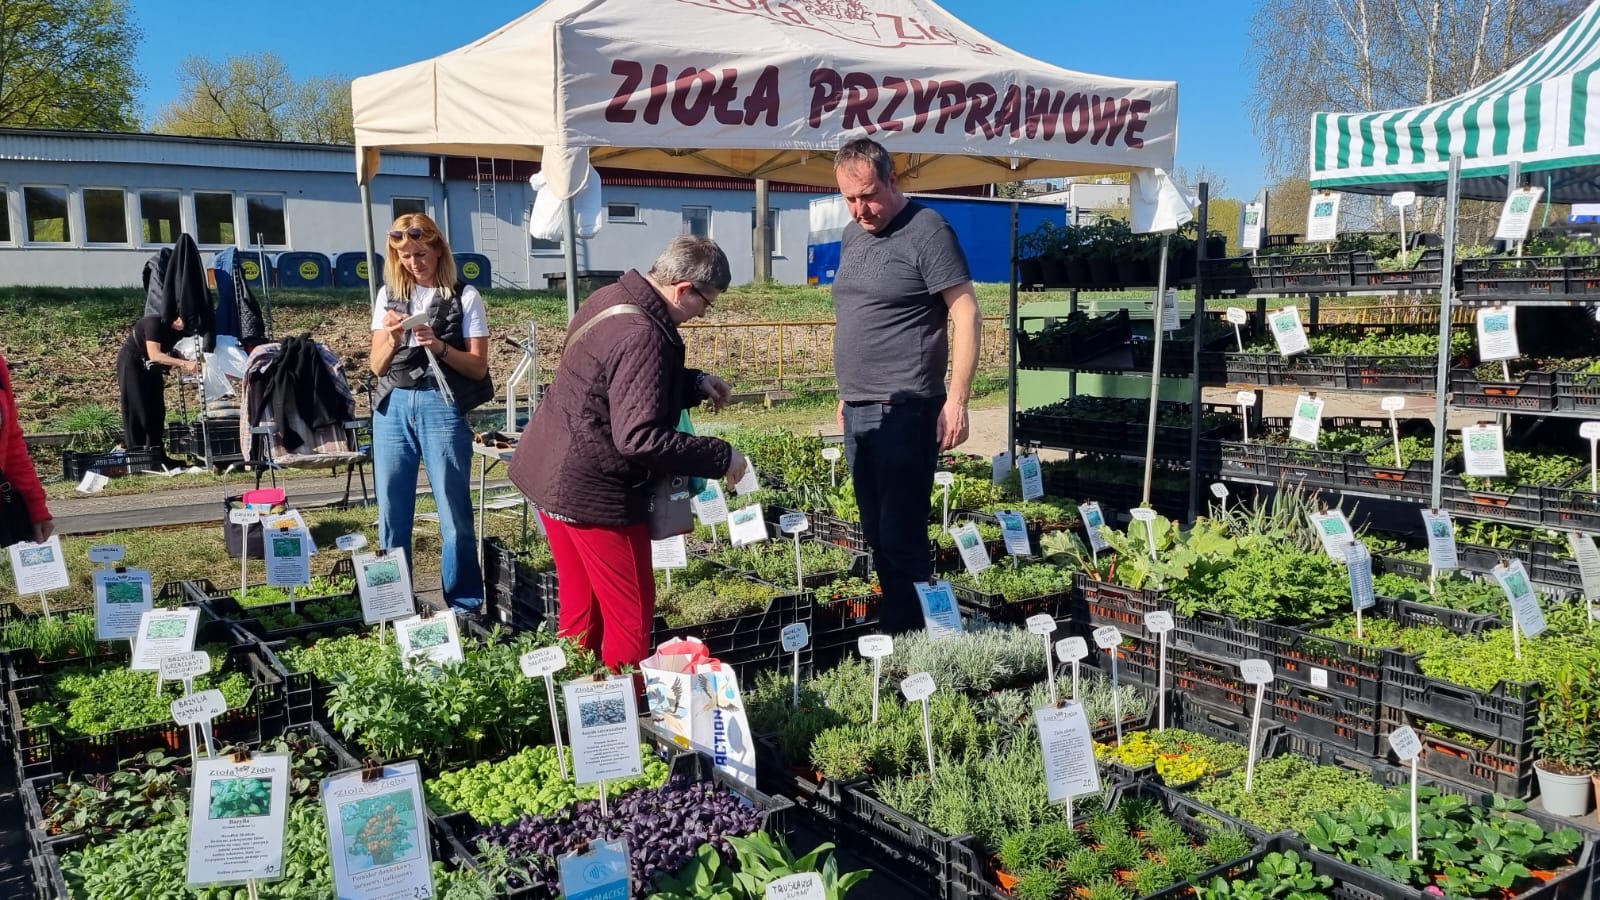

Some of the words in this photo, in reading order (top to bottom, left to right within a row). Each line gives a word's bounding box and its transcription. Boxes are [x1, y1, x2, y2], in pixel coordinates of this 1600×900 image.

[605, 59, 780, 127] ZIOŁA
[808, 67, 1152, 149] PRZYPRAWOWE
[713, 709, 728, 767] ACTION
